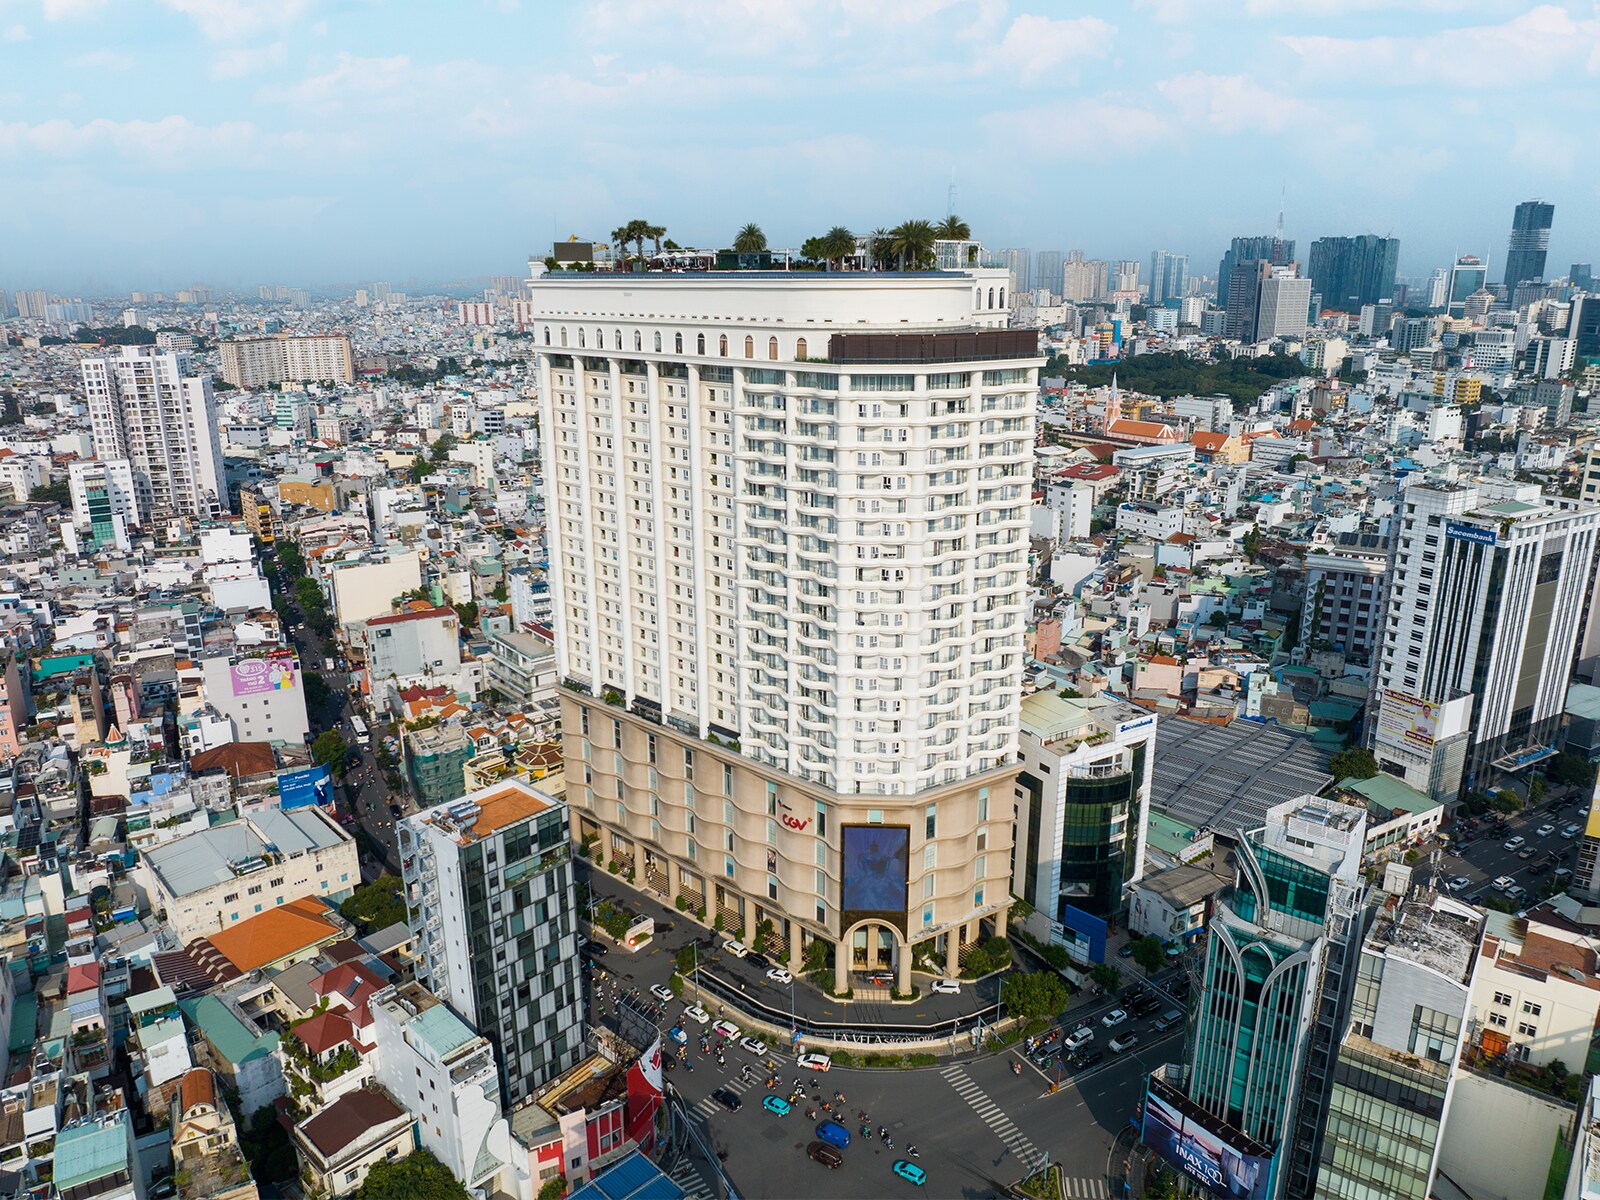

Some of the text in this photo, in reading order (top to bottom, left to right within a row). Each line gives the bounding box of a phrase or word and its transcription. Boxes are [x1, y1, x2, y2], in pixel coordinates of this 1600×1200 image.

[1446, 526, 1493, 542] Sacombank
[782, 813, 808, 830] CGV
[1175, 1145, 1202, 1169] INAX
